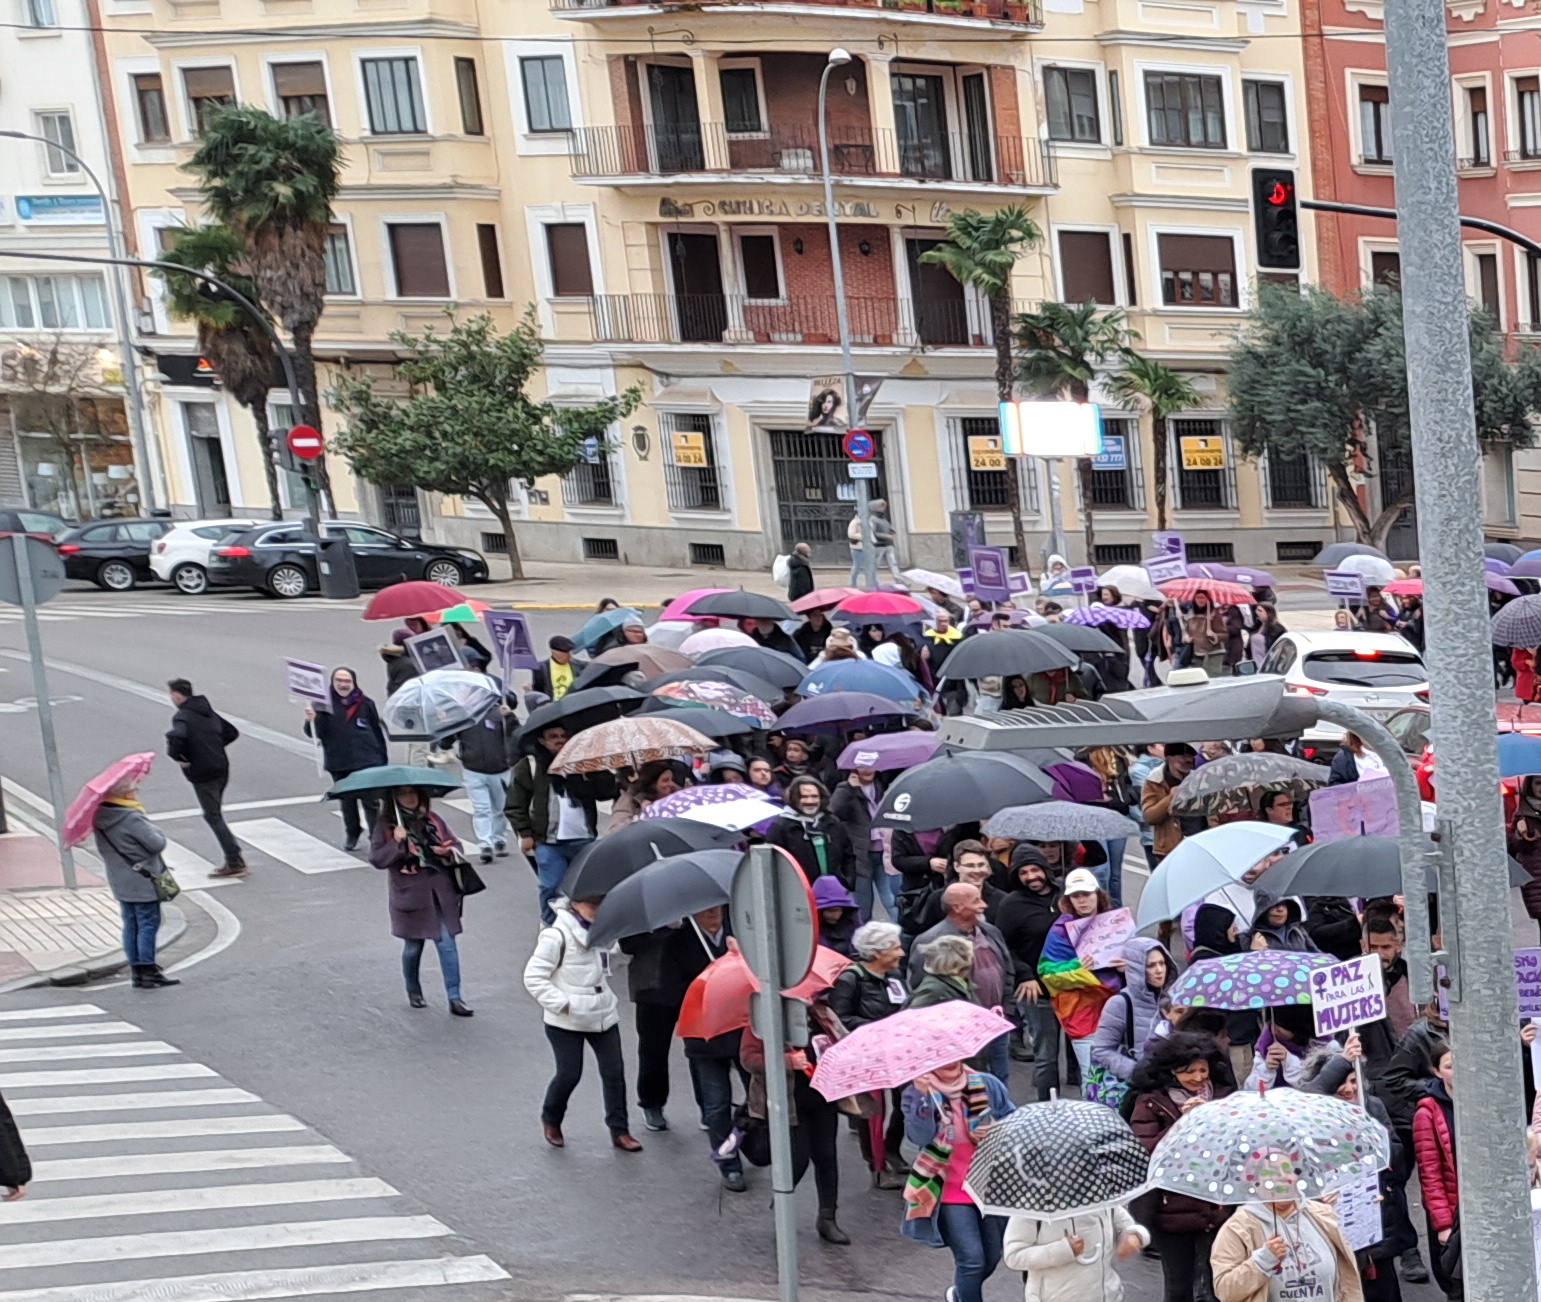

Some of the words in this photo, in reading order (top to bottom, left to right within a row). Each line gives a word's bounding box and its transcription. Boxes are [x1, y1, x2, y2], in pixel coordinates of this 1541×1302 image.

[1330, 960, 1364, 987] PAZ
[1325, 991, 1348, 1003] PARA
[1316, 994, 1384, 1034] MUJERES
[1279, 1285, 1324, 1298] CUENTA
